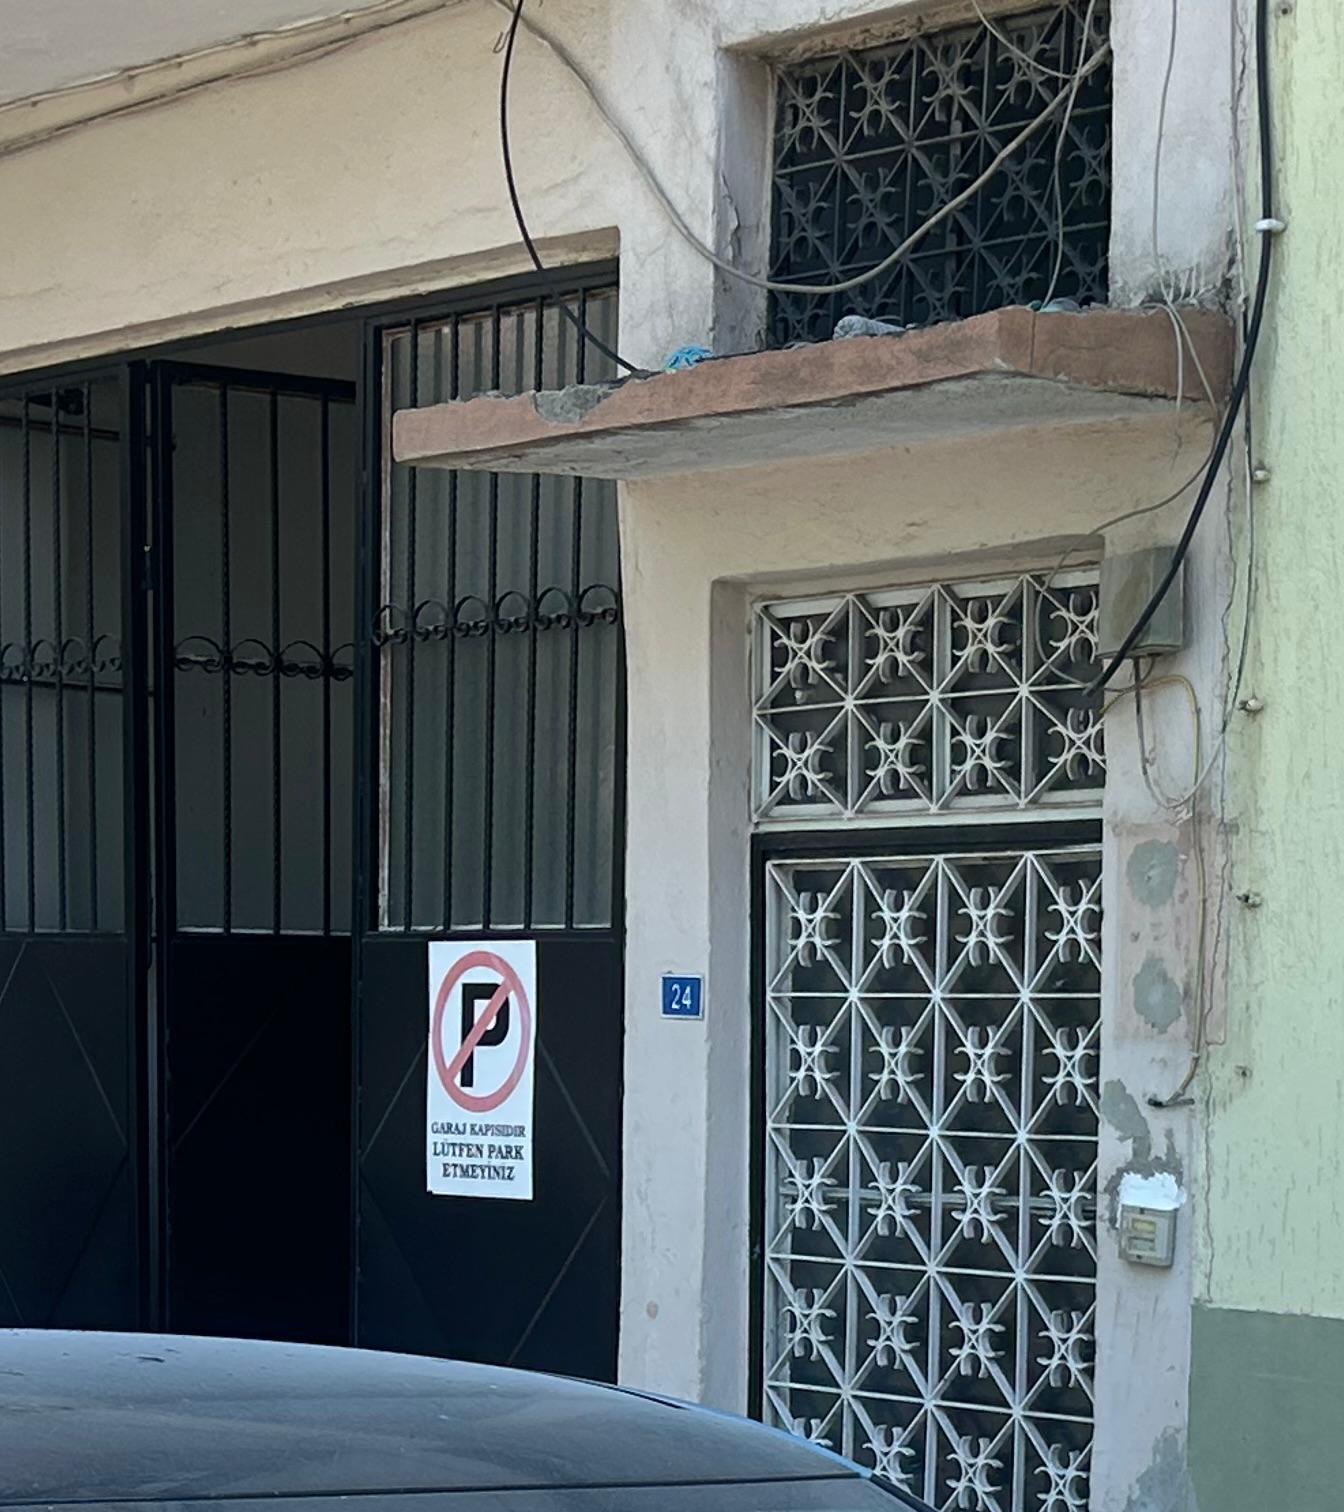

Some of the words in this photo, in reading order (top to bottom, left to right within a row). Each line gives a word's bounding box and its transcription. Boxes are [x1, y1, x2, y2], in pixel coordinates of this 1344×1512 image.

[671, 983, 692, 1010] 24
[431, 1122, 467, 1135] GARAJ
[470, 1123, 526, 1137] KAPISIDIR
[433, 1138, 484, 1158] LÜTFEN
[487, 1143, 524, 1160] PARK
